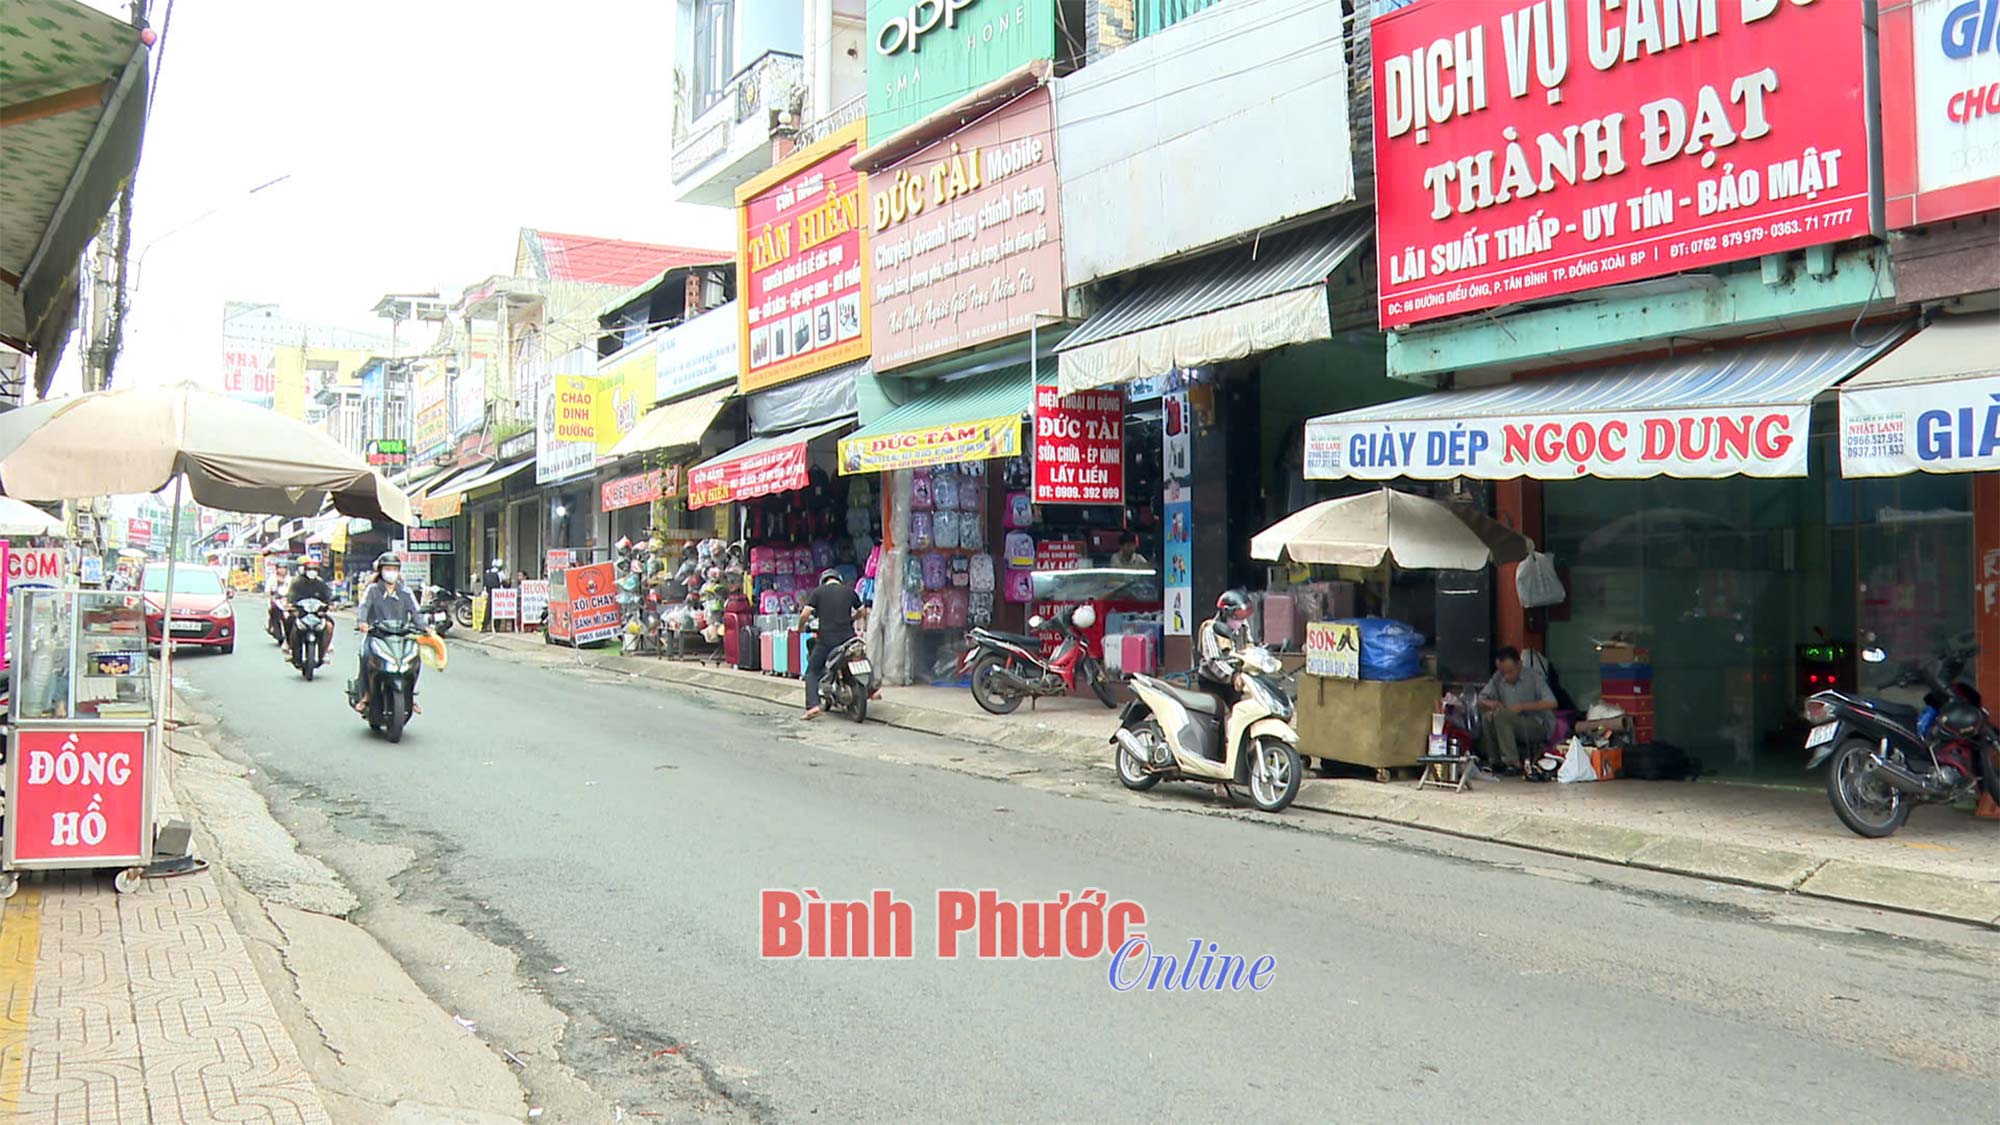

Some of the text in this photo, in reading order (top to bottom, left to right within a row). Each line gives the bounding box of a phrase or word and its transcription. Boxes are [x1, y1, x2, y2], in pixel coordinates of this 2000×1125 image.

[1941, 0, 2000, 60] GI
[1385, 25, 1487, 144] DỊCH
[1501, 0, 1571, 105] VỤ
[1423, 67, 1778, 220] THÀNH ĐẠT
[874, 136, 1043, 232] ĐỨC TÀI Mobile
[749, 179, 859, 273] TÂN HIỀN
[875, 238, 911, 270] Chuyên
[913, 217, 946, 255] doanh
[978, 196, 1012, 231] chính
[1390, 147, 1842, 285] LÃI SUẤT THẤP UY TÍN BẢO MẬT
[1504, 275, 1523, 291] TÂN
[1525, 271, 1548, 287] BÌNH
[1553, 268, 1568, 282] TP.
[1601, 253, 1626, 272] XOÀI
[1630, 251, 1646, 266] BP
[1670, 243, 1689, 258] ĐT:
[1691, 236, 1718, 254] 0762
[1805, 216, 1819, 232] 71
[1822, 209, 1853, 228] 7777
[563, 406, 590, 421] DINH
[1038, 390, 1059, 412] ĐIỆN
[1087, 396, 1097, 411] DI
[1038, 412, 1121, 440] ĐỨC TÀI
[924, 426, 977, 445] TÂM
[1038, 441, 1120, 465] SỬA CHỮA ÉP KÍNH
[1349, 413, 1794, 475] GIÀY DÉP NGỌC DUNG
[1050, 464, 1076, 484] LẤY
[1083, 487, 1101, 499] 392
[591, 593, 614, 608] CHAY
[603, 611, 618, 624] CHAY
[28, 733, 132, 787] ĐỒNG
[51, 793, 108, 846] HỒ
